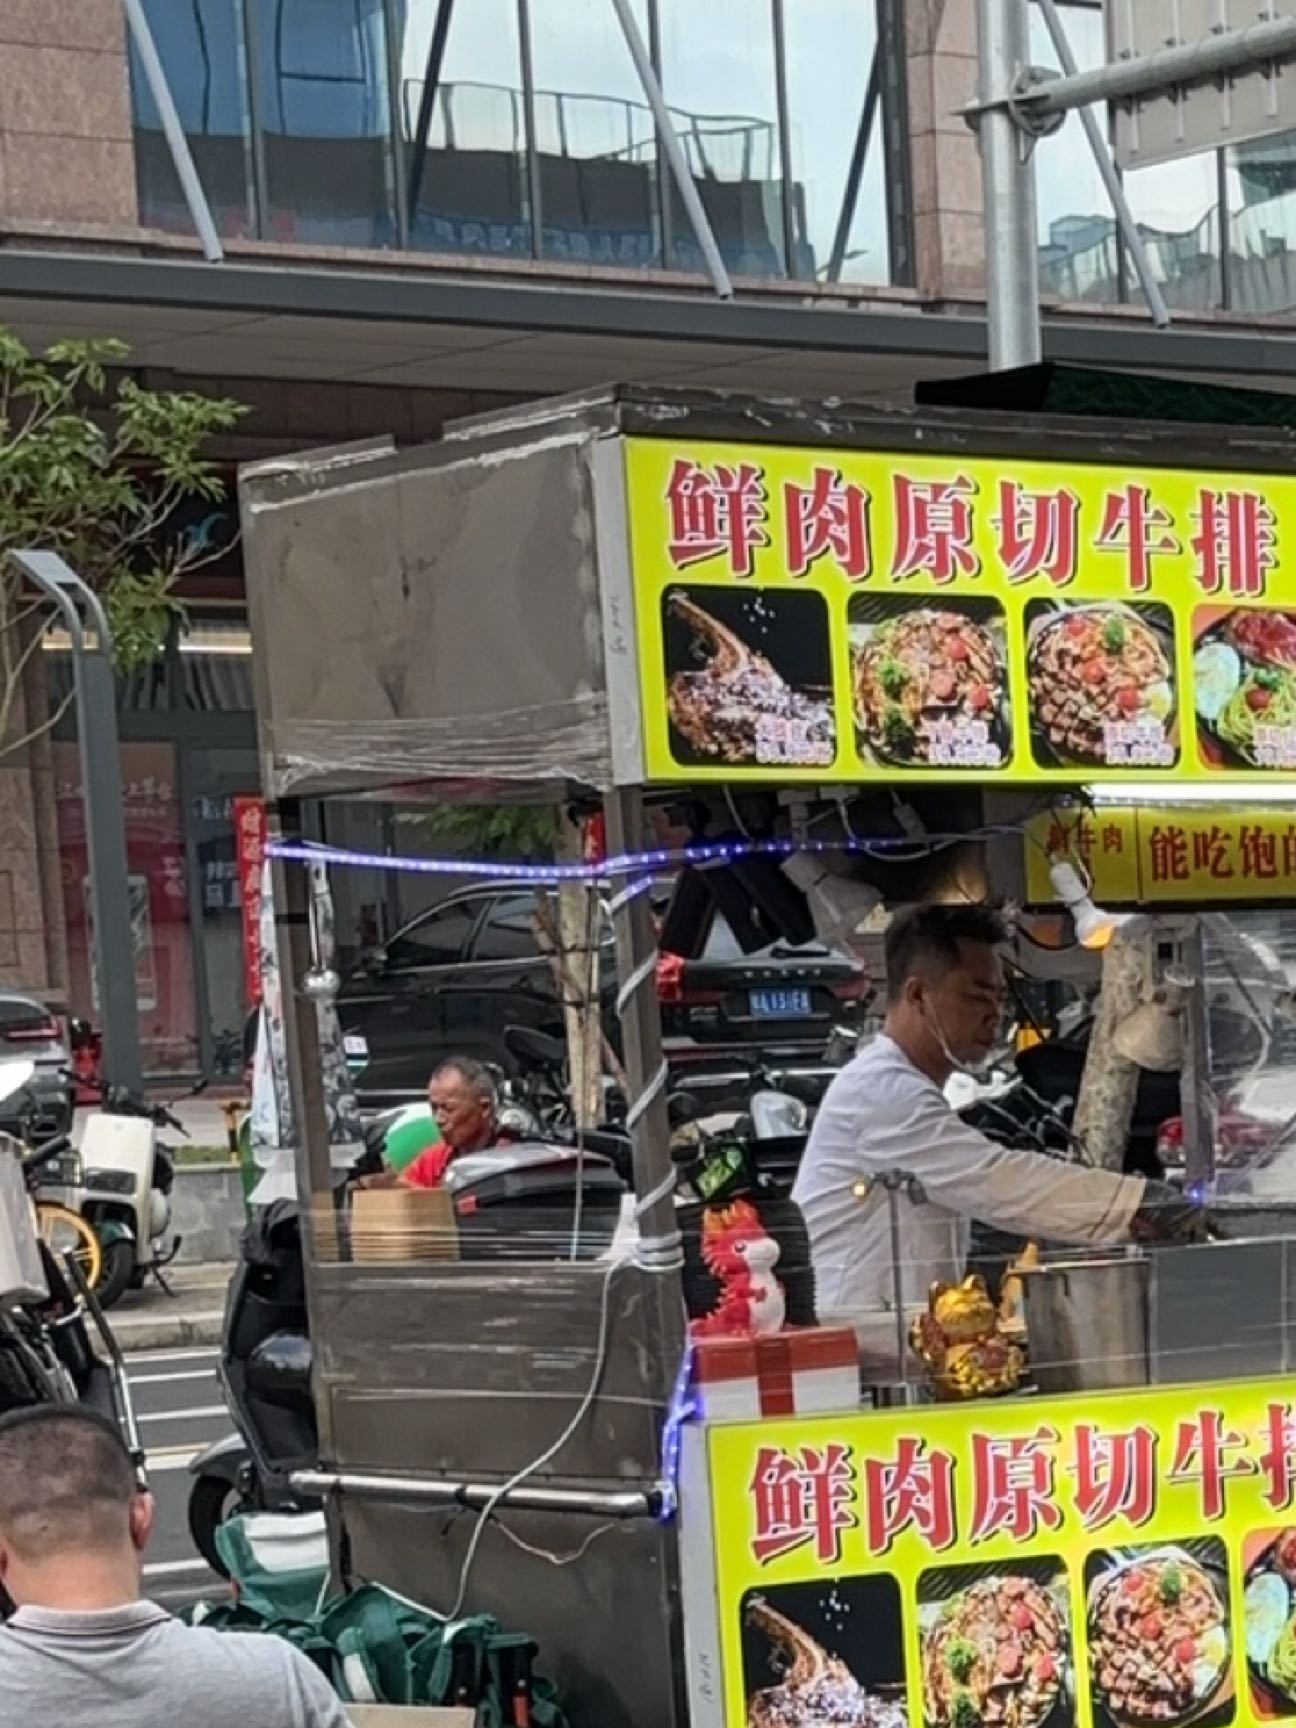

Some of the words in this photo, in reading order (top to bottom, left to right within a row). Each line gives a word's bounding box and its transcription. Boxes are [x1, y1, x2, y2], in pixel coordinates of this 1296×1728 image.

[667, 458, 1279, 595] 鲜肉原切牛排
